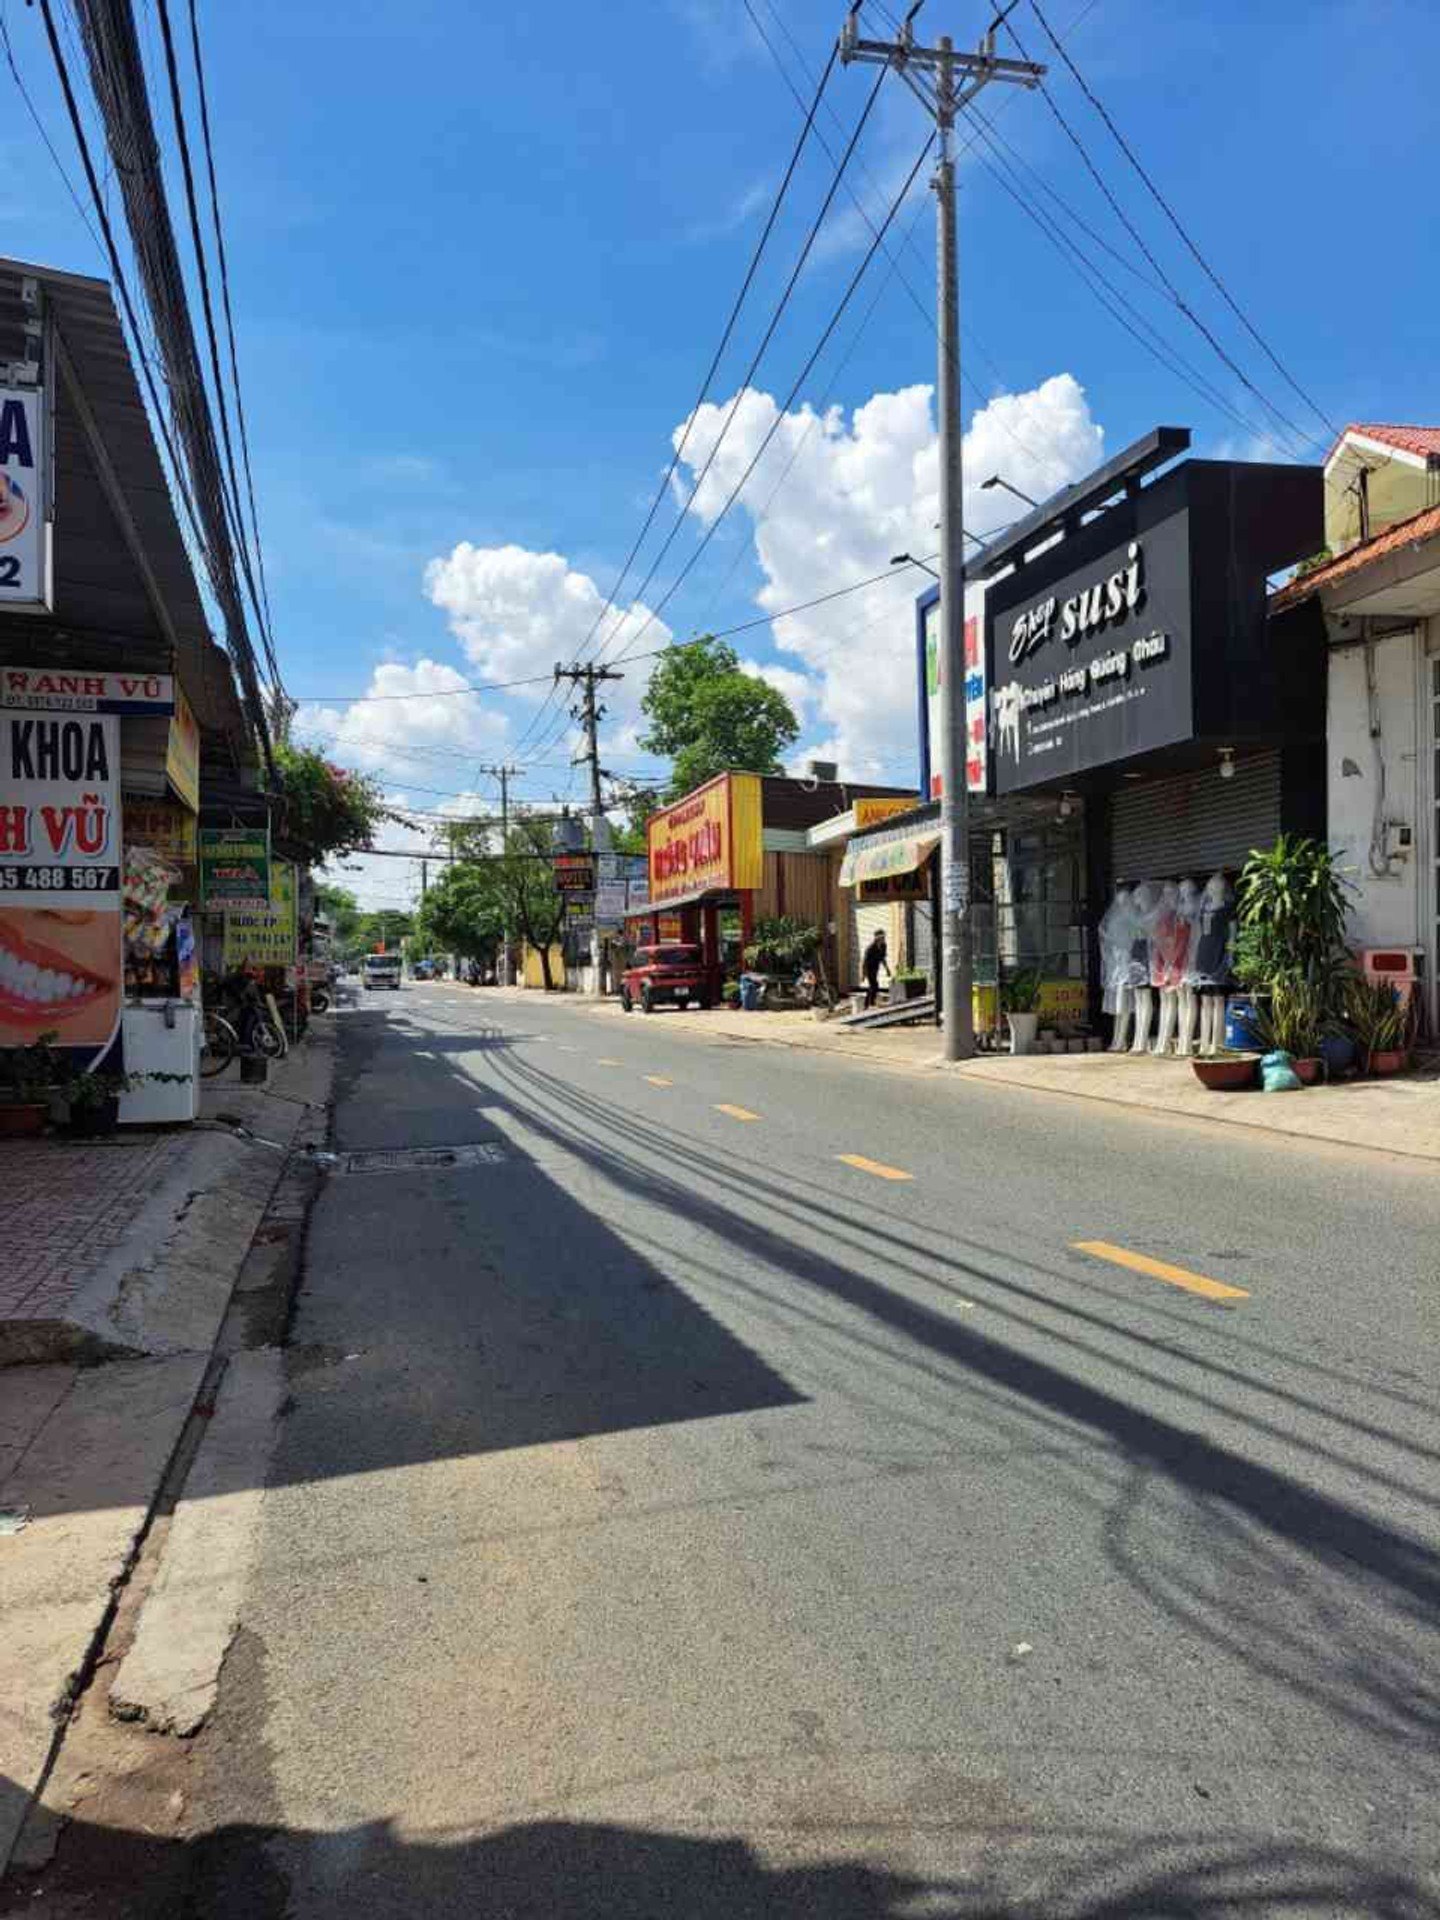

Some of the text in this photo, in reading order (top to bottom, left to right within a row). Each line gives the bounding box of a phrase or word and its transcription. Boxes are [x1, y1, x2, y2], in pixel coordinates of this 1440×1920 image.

[1060, 541, 1142, 641] susi
[33, 673, 162, 698] ANH VŨ
[11, 719, 109, 781] KHOA
[40, 791, 107, 854] VŨ
[24, 867, 66, 889] 488
[71, 867, 111, 889] 567
